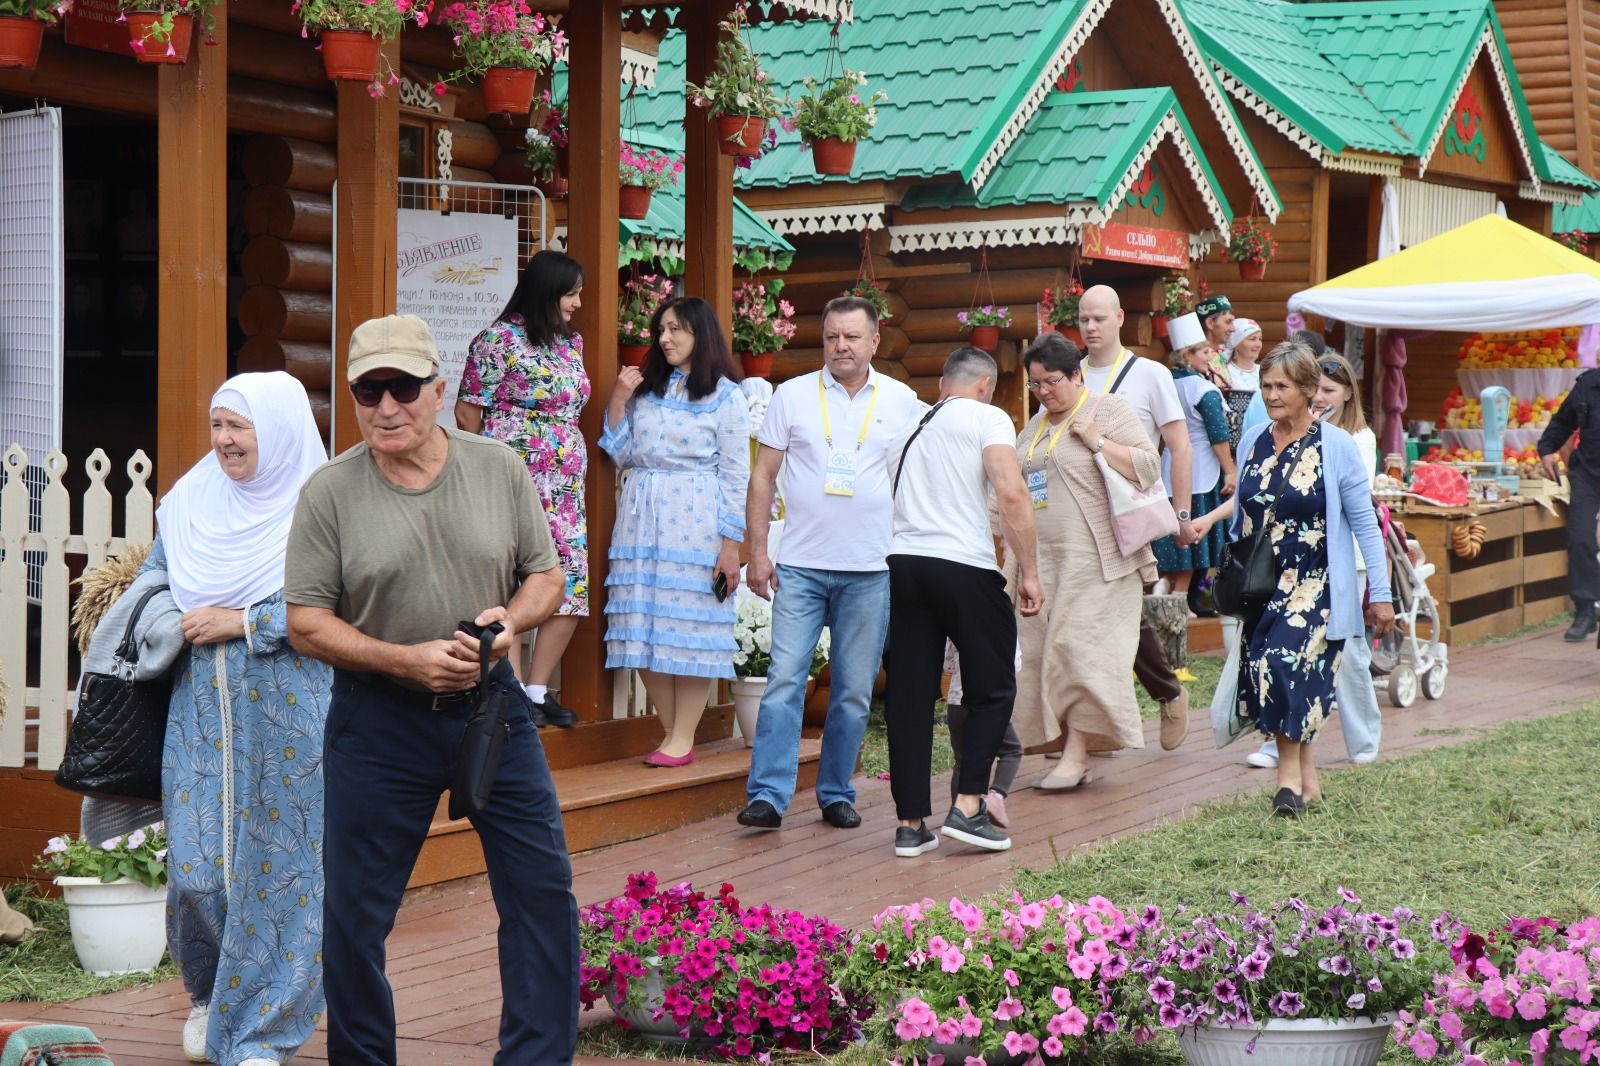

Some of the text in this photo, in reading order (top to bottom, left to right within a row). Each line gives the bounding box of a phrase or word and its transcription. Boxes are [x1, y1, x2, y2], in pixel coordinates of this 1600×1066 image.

[1126, 231, 1157, 248] СЕЛЬПО
[397, 235, 482, 272] БЪЯВЛЕНИЕ
[429, 288, 438, 301] 16
[474, 291, 499, 304] 10.30
